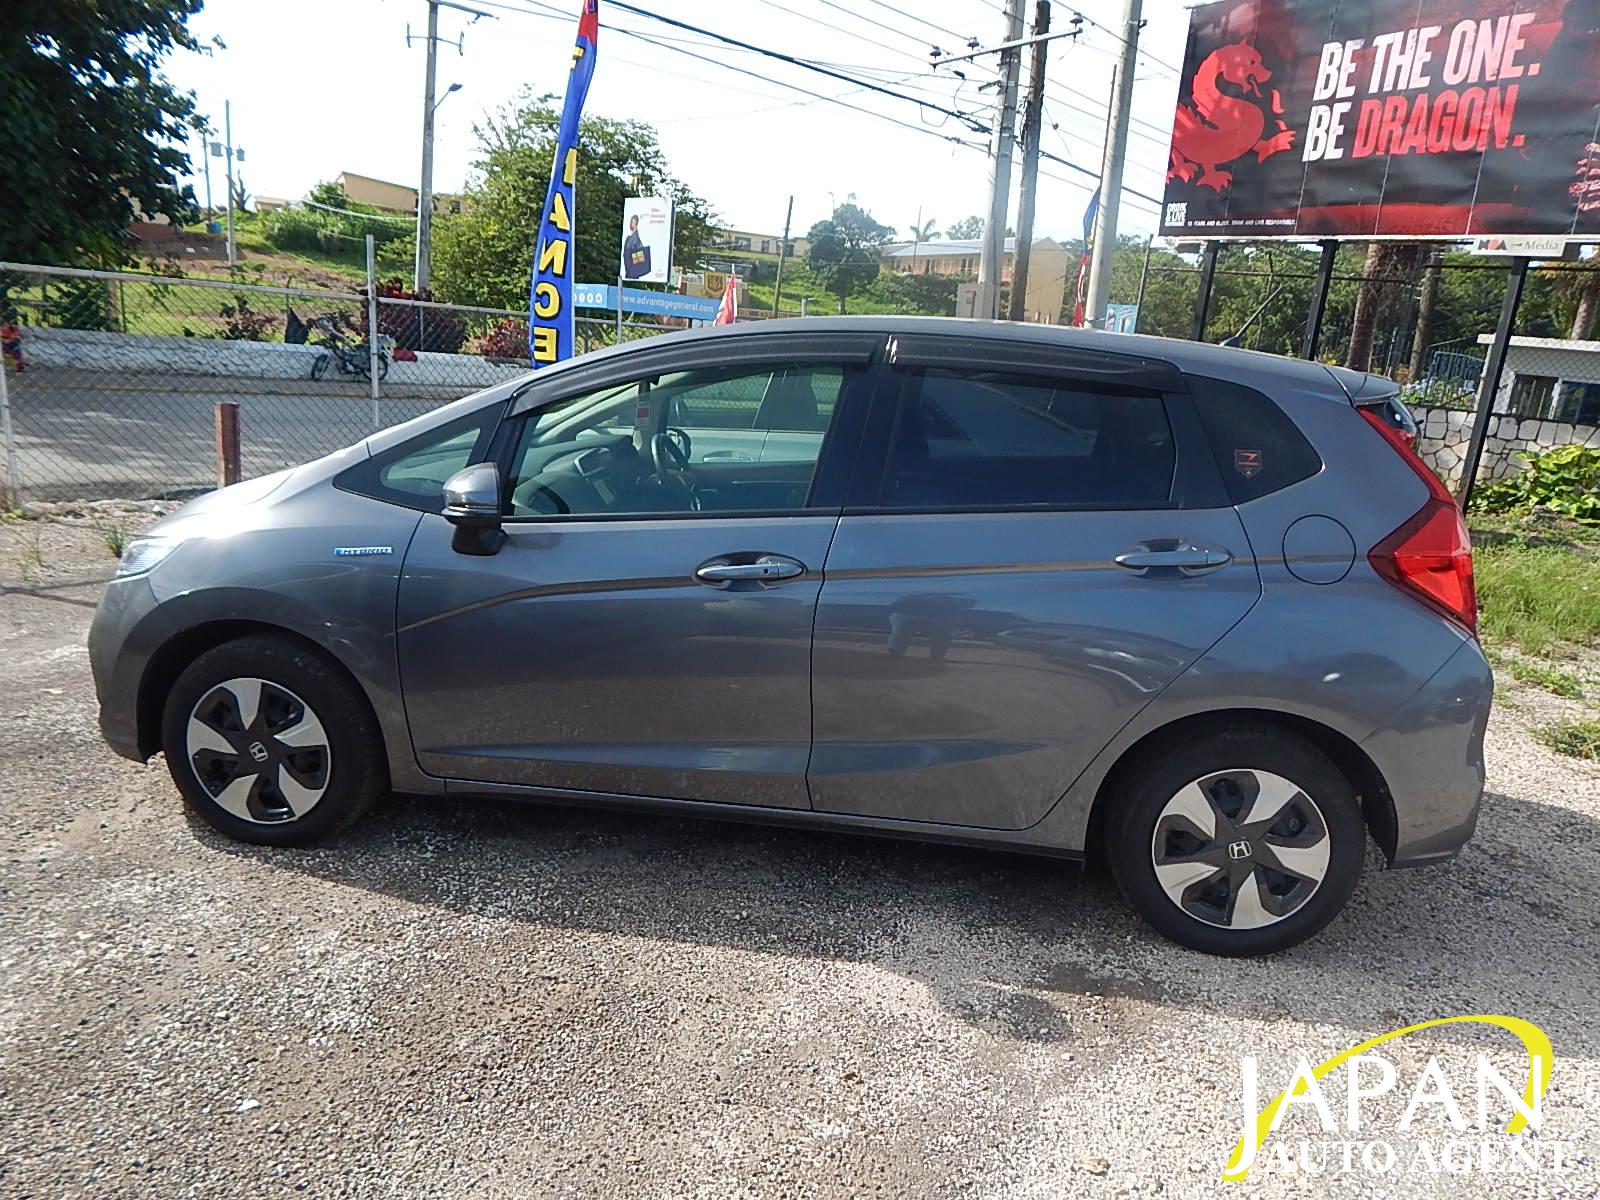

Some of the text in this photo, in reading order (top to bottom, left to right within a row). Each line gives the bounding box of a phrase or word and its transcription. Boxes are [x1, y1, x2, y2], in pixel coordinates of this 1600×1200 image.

[1313, 12, 1541, 101] BE THE ONE.
[1302, 84, 1526, 162] BE DRAGON.
